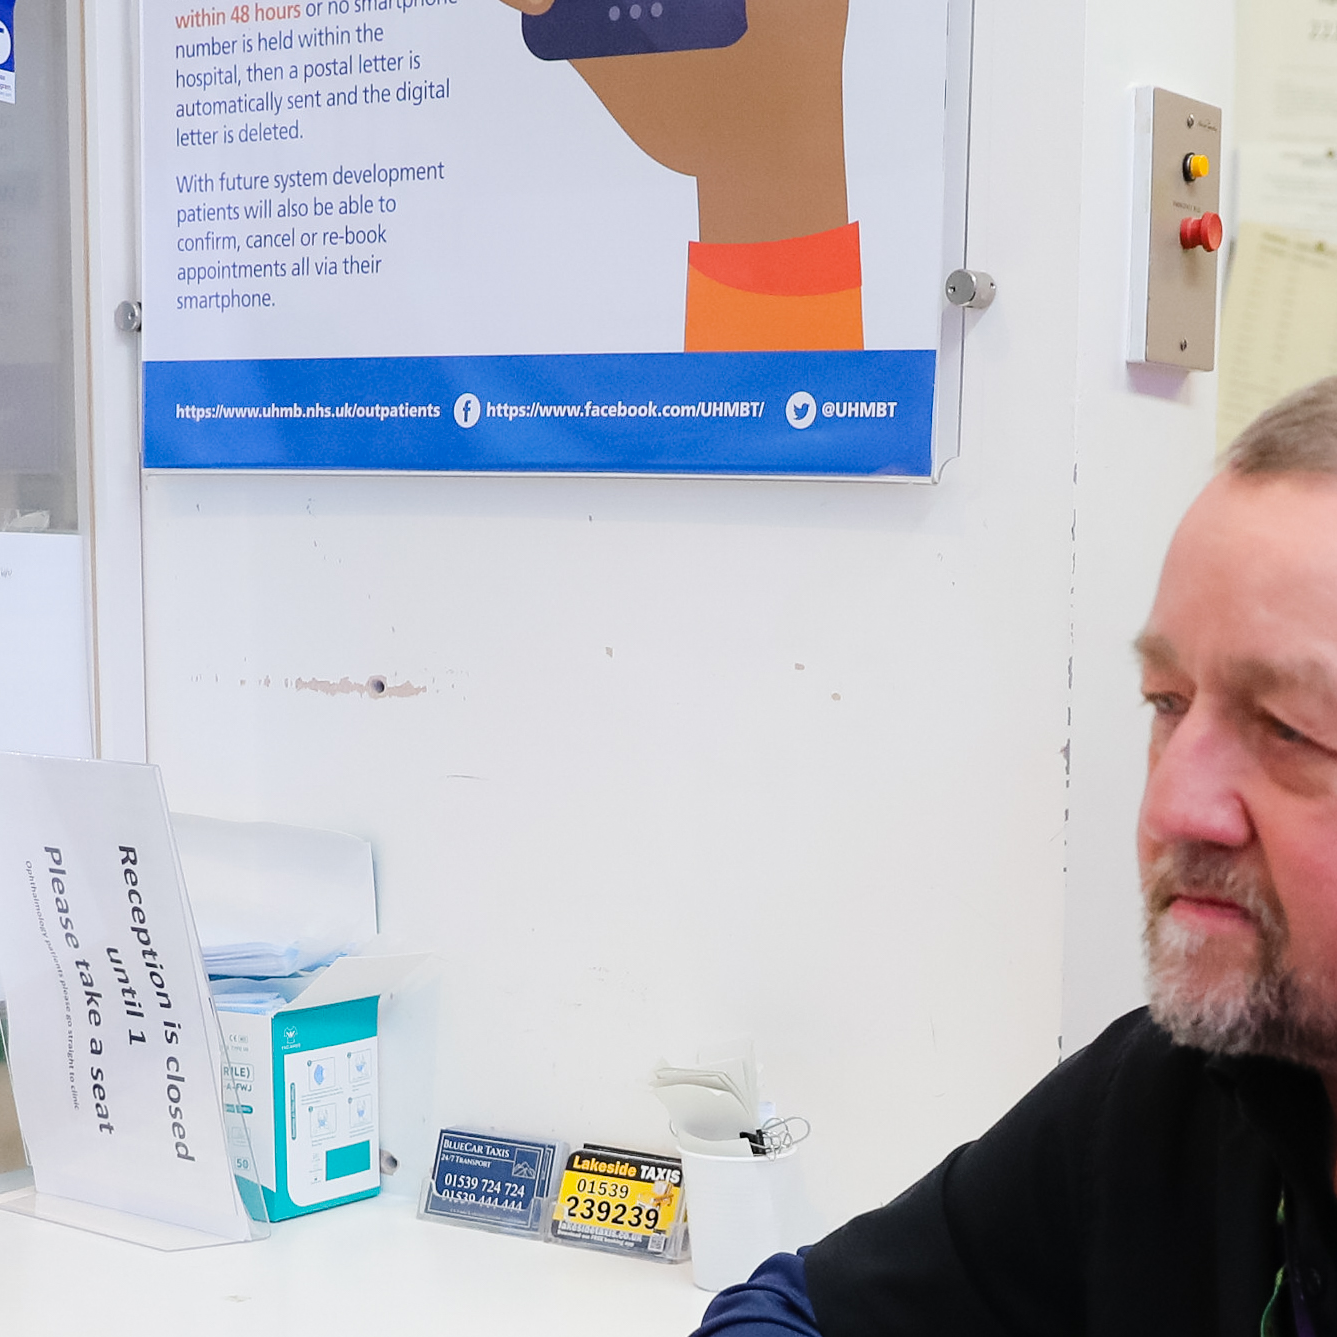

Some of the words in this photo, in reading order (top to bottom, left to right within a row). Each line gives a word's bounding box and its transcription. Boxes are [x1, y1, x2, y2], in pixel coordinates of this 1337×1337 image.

[176, 9, 225, 28] within
[231, 5, 250, 23] 48
[255, 3, 300, 21] hours
[306, 0, 323, 17] or
[328, 0, 349, 14] no
[355, 0, 457, 13] smartp
[176, 36, 237, 58] number
[243, 34, 252, 53] is
[258, 30, 293, 51] held
[298, 25, 350, 48] within
[355, 23, 383, 42] the
[176, 64, 241, 91] hospital,
[247, 63, 283, 82] then
[289, 64, 298, 79] a
[304, 55, 352, 82] postal
[358, 53, 403, 73] letter
[410, 50, 420, 69] is
[176, 91, 282, 118] automatically
[287, 89, 321, 109] sent
[326, 85, 357, 106] and
[363, 84, 390, 103] the
[396, 79, 450, 105] digital
[176, 128, 217, 146] letter
[224, 125, 234, 144] is
[239, 120, 303, 142] deleted.
[176, 173, 214, 193] With
[219, 171, 269, 191] future
[274, 169, 327, 193] system
[333, 162, 444, 186] development
[177, 202, 239, 227] patients
[245, 199, 271, 219] will
[277, 198, 308, 217] also
[314, 196, 333, 216] be
[339, 194, 373, 215] able
[379, 196, 396, 213] to
[177, 231, 240, 252] confirm,
[246, 227, 295, 248] cancel
[300, 230, 317, 246] or
[323, 223, 386, 245] re-book
[177, 259, 286, 285] appointments
[292, 256, 309, 276] all
[315, 256, 337, 275] via
[342, 254, 382, 274] their
[177, 289, 275, 312] smartphone.
[176, 403, 440, 422] https://www.uhmb.nhs.uk/outpatients
[486, 401, 765, 419] https://www.facebook.com/UHMBT/
[822, 401, 897, 418] @UHMBT
[44, 846, 79, 949] Please
[118, 845, 173, 1010] Reception
[75, 958, 103, 1027] take
[106, 947, 144, 1018] until
[128, 1028, 146, 1046] 1
[163, 1019, 181, 1044] is
[67, 1029, 75, 1071] straight
[90, 1039, 103, 1056] a
[69, 1071, 75, 1083] to
[70, 1084, 80, 1110] clinic
[90, 1066, 114, 1134] seat
[166, 1056, 196, 1162] closed
[237, 1159, 249, 1169] 50
[441, 1153, 455, 1162] 24/7
[573, 1155, 637, 1177] Lakeside
[640, 1166, 681, 1184] TAXIS
[445, 1173, 478, 1190] 01539
[482, 1179, 501, 1193] 724
[505, 1183, 525, 1198] 724
[577, 1179, 629, 1198] 01539
[566, 1196, 659, 1229] 239239
